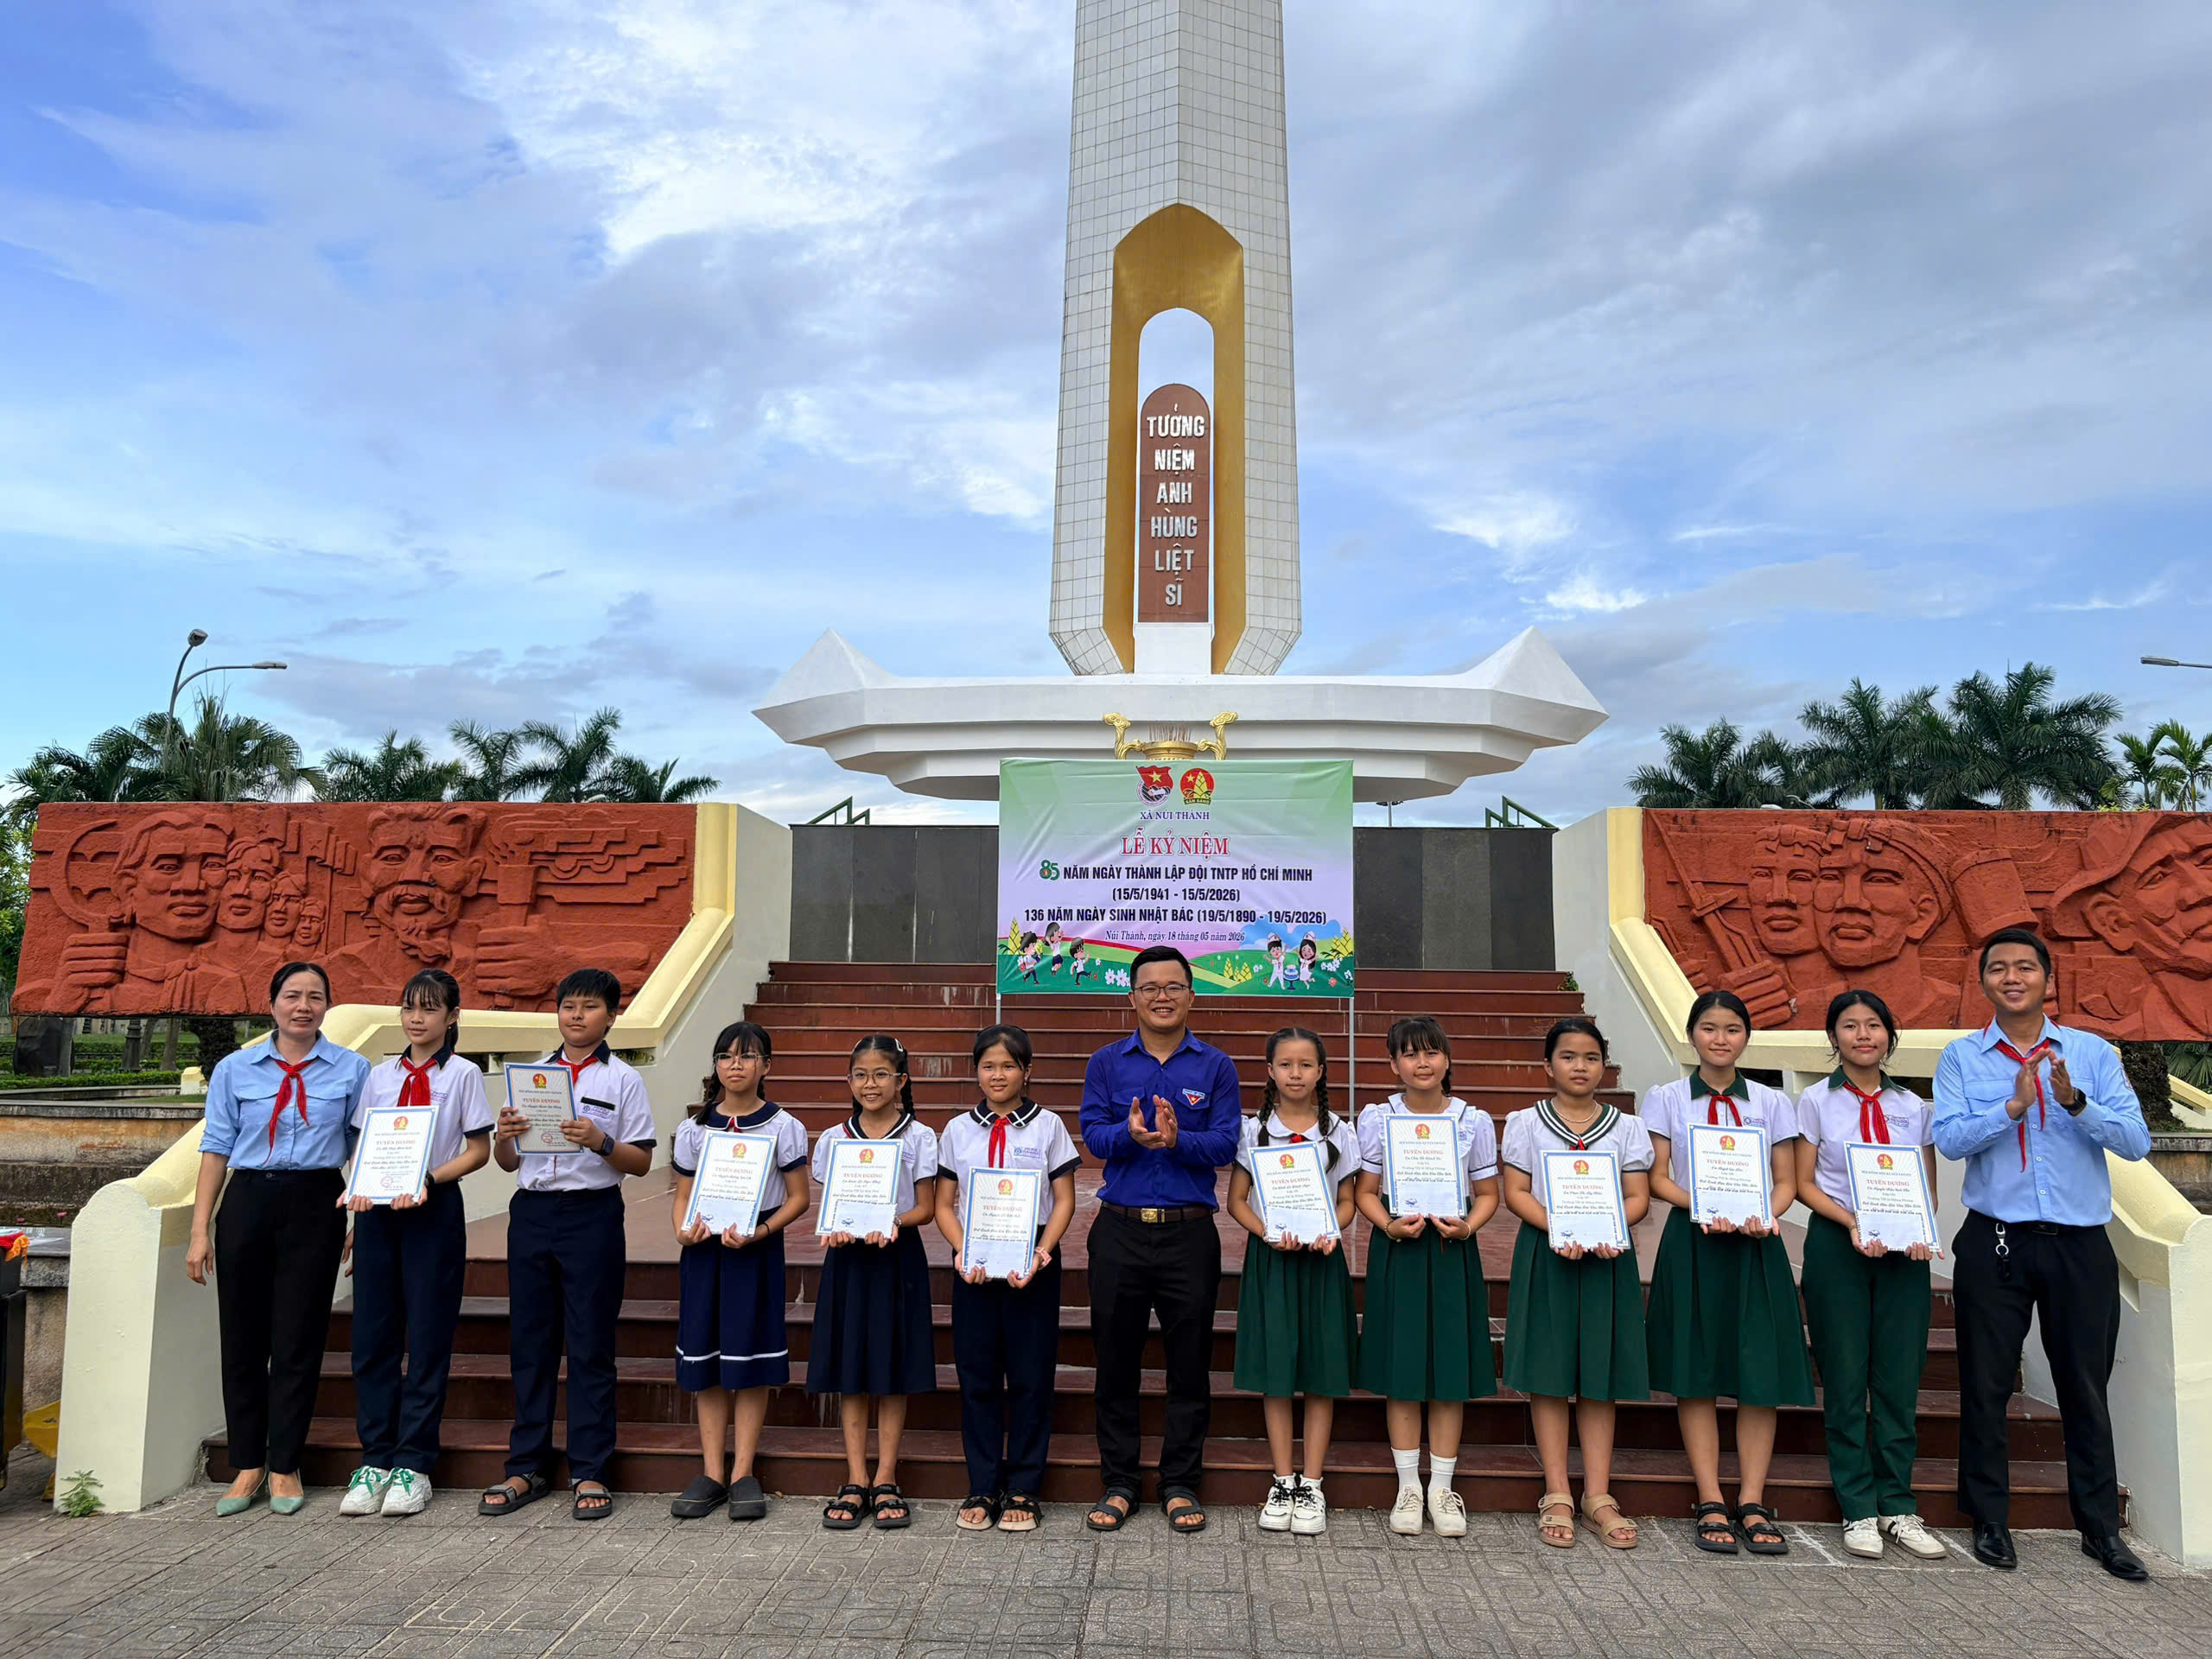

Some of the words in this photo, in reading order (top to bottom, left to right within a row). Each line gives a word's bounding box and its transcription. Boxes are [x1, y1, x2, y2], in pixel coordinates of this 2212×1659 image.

[1147, 403, 1205, 437] TƯỞNG
[1154, 442, 1195, 475] NIỆM
[1156, 482, 1192, 504] ANH
[1151, 508, 1198, 538] HÙNG
[1154, 543, 1195, 575] LIỆT
[1165, 577, 1183, 606] SĨ
[1140, 810, 1153, 819] XÃ
[1155, 810, 1173, 819] NÚI
[1175, 810, 1210, 819] THÀNH
[1121, 827, 1145, 855] LỄ
[1149, 830, 1175, 855] KỶ
[1179, 831, 1229, 859] NIỆM
[1039, 859, 1060, 880] 85
[1064, 865, 1089, 880] NĂM
[1092, 864, 1122, 880] NGÀY
[1125, 864, 1161, 880] THÀNH
[1165, 864, 1185, 882] LẬP
[1189, 865, 1207, 882] ĐỘI
[1211, 867, 1237, 880] TNTP
[1242, 864, 1256, 880] HỒ
[1261, 866, 1279, 880] CHÍ
[1282, 868, 1313, 881] MINH
[1113, 887, 1169, 902] (15/5/1941
[1181, 888, 1240, 902] 15/5/2026)
[1024, 909, 1045, 921] 136
[1047, 907, 1073, 921] NĂM
[1077, 906, 1106, 922] NGÀY
[1109, 909, 1135, 922] SINH
[1139, 906, 1168, 925] NHẬT
[1172, 906, 1193, 922] BÁC
[1198, 910, 1256, 923] (19/5/1890
[1268, 911, 1326, 925] 19/5/2026)
[1105, 930, 1119, 940] Núi
[1122, 931, 1147, 941] Thành,
[1148, 931, 1166, 943] ngày
[1168, 931, 1176, 940] 18
[1178, 931, 1198, 943] tháng
[1200, 931, 1210, 941] 05
[1211, 932, 1227, 941] năm
[1228, 932, 1245, 941] 2026
